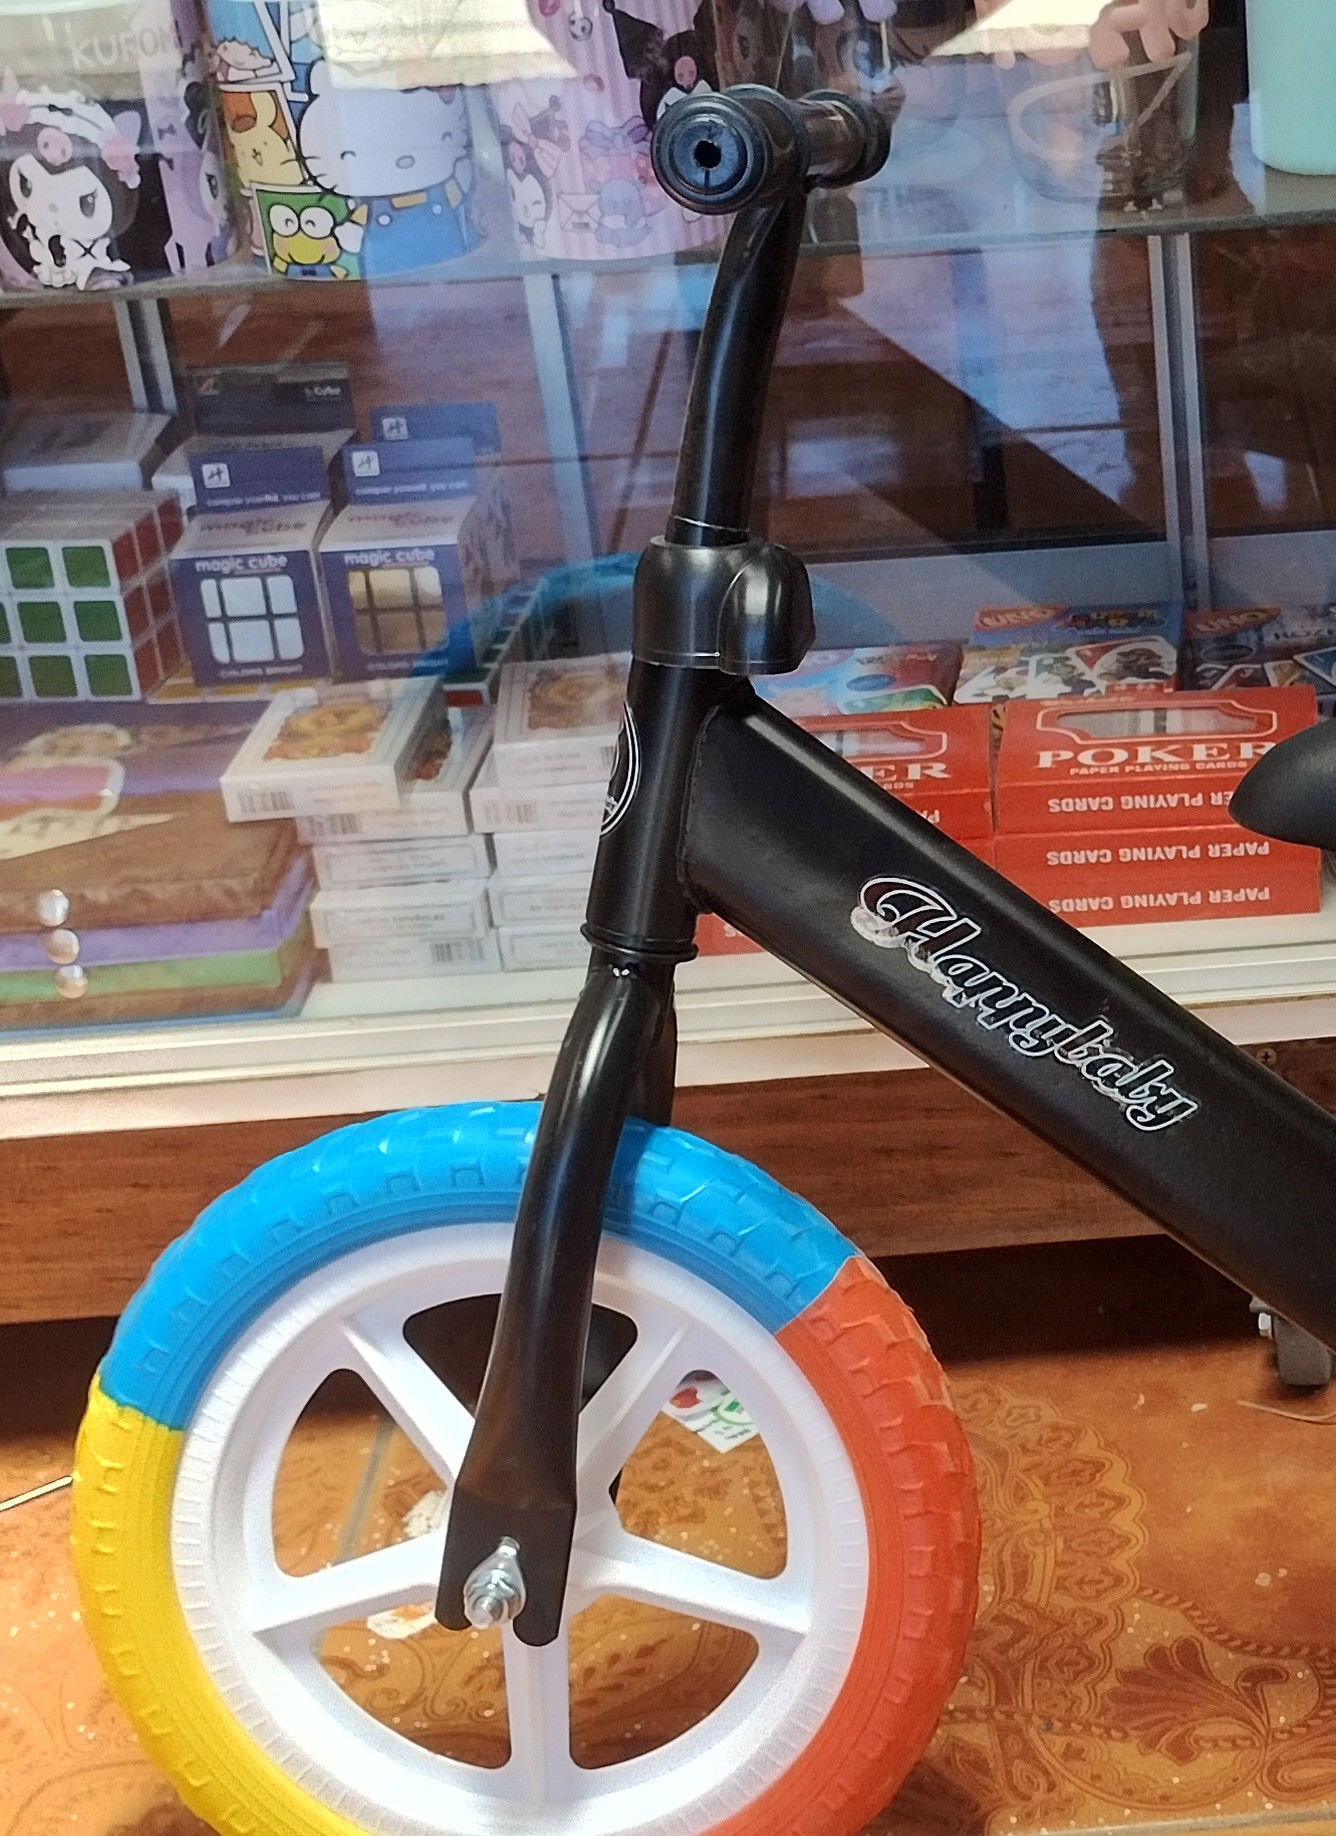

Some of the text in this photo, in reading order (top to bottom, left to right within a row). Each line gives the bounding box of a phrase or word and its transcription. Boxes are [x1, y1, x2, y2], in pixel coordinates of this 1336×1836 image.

[194, 557, 244, 574] magic
[248, 554, 288, 569] cube
[345, 548, 436, 567] magic cube
[1070, 760, 1248, 777] PAPER PLAYING CARDS
[1048, 796, 1114, 813] CARDS
[1121, 792, 1203, 810] PLAYING
[1046, 841, 1270, 866] PAPER PLAYING CARDS
[1048, 886, 1270, 914] PAPER PLAYING CARDS
